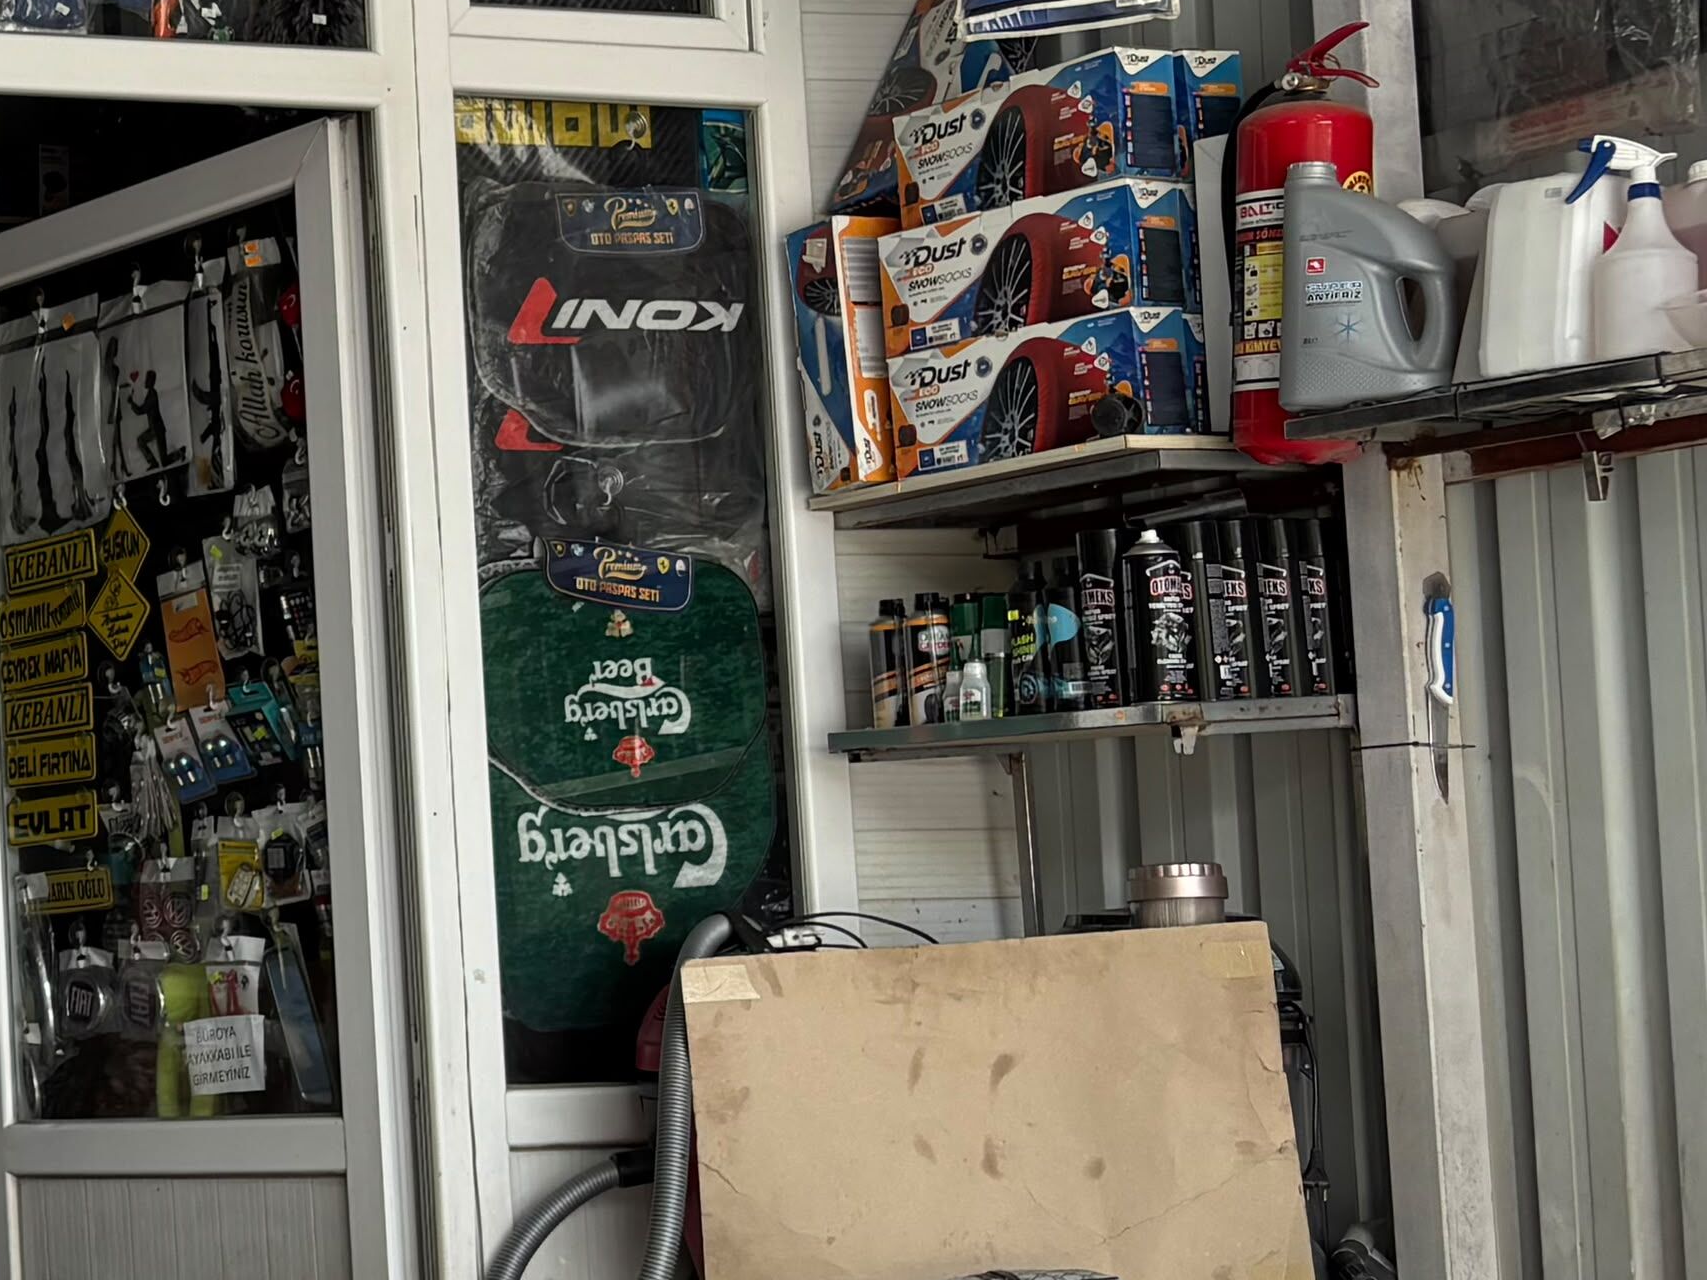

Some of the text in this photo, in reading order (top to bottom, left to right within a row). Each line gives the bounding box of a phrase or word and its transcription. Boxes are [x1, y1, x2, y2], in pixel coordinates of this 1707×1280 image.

[604, 196, 657, 231] Premium
[590, 232, 612, 246] OTO
[550, 297, 745, 334] KONI
[11, 539, 88, 585] KEBANLI
[593, 546, 648, 580] Premium
[575, 576, 597, 591] OTO
[589, 656, 654, 689] Beer
[8, 691, 87, 734] KEBANLI
[564, 682, 692, 737] Carlsberg
[9, 746, 38, 780] DELİ
[14, 804, 91, 839] EVLAT
[516, 802, 728, 889] Carlsberg
[70, 986, 94, 1018] FIAT
